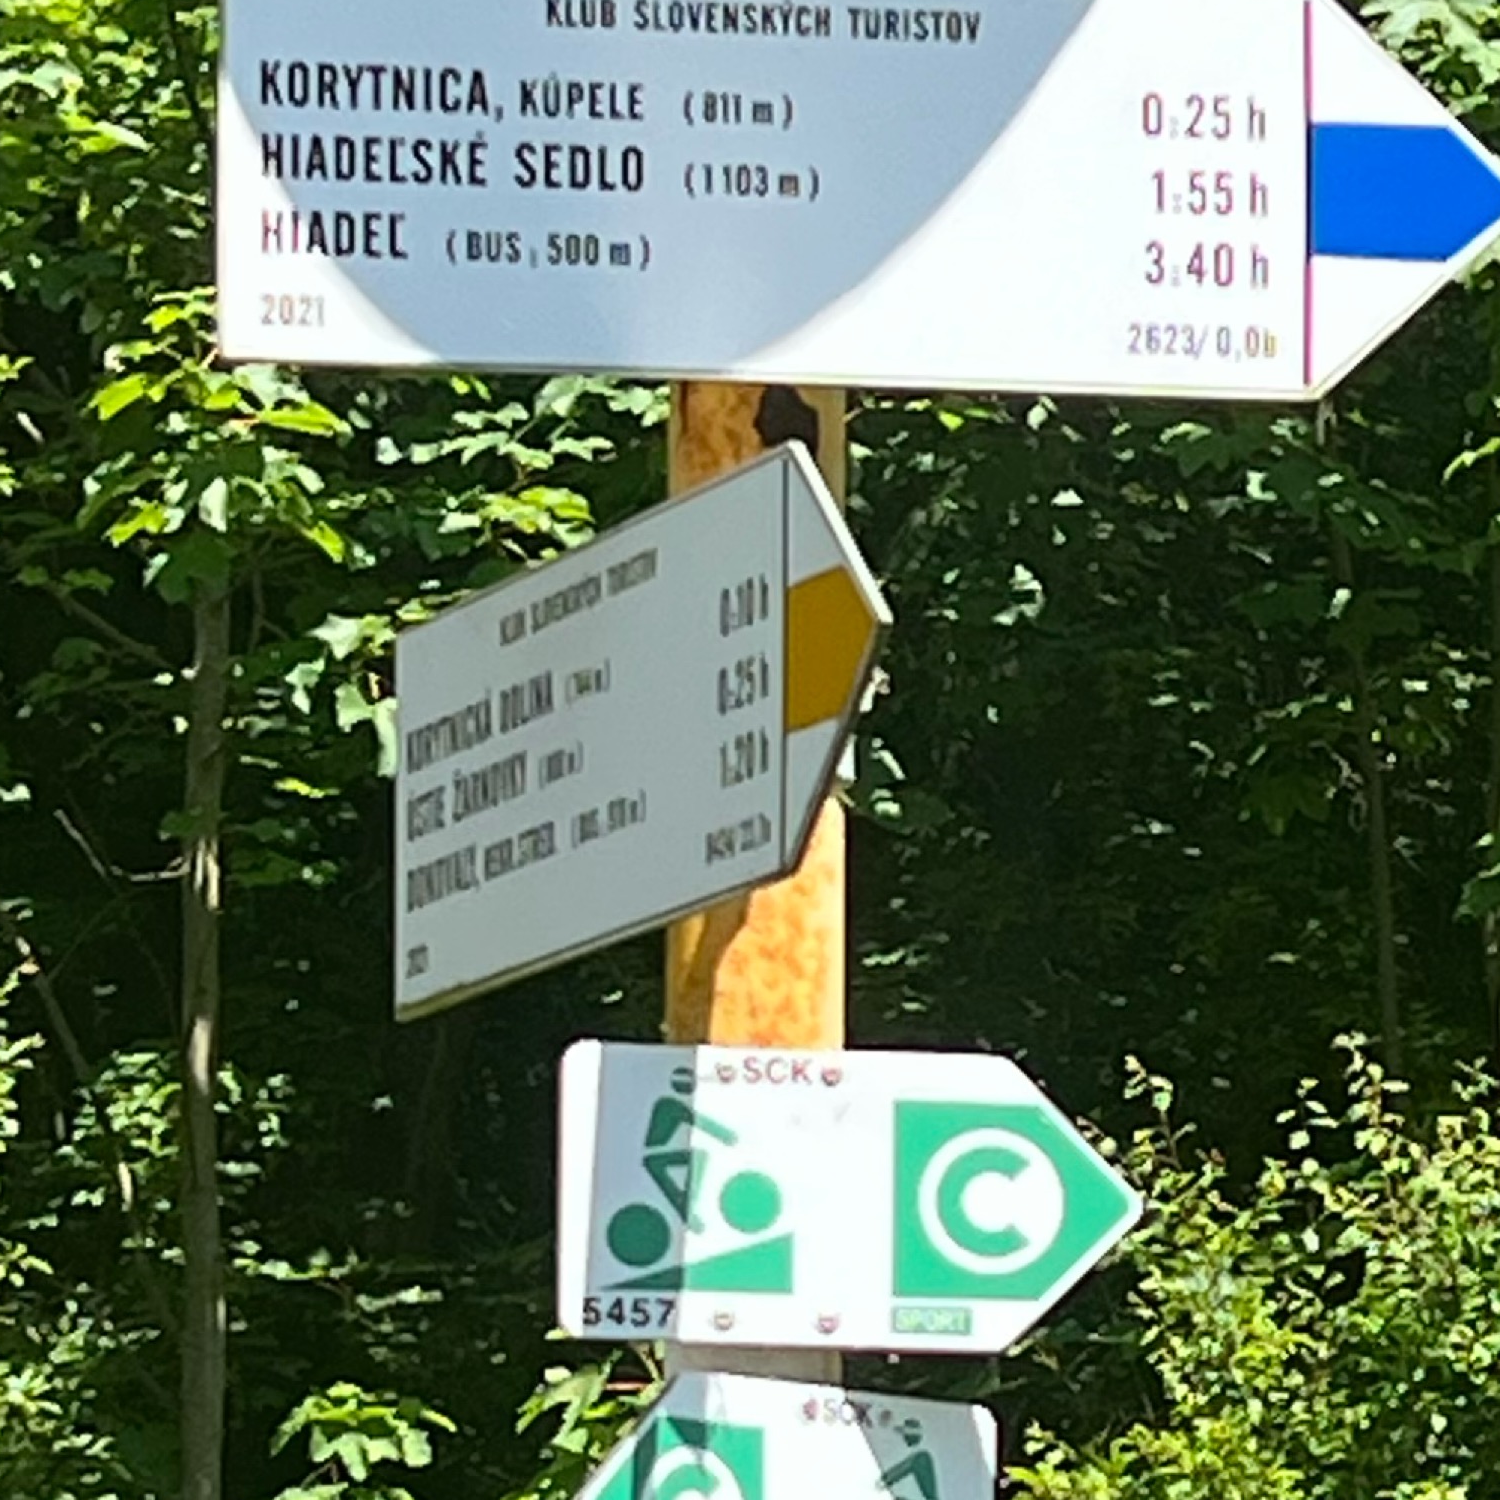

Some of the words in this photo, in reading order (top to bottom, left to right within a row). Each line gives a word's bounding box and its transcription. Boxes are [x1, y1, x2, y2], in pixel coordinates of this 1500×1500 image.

[847, 7, 982, 44] TURISTOV
[259, 59, 504, 123] KORYTNICA,
[519, 71, 645, 122] KÚPELE
[1247, 95, 1267, 142] h
[260, 130, 490, 187] HIADEĽSKÉ
[513, 142, 645, 192] SEDLO
[1249, 172, 1270, 218] h
[260, 208, 410, 261] HIADEĽ
[1251, 244, 1270, 290] h
[260, 293, 325, 328] 2021
[742, 1056, 814, 1084] SCK
[582, 1295, 676, 1328] 5457
